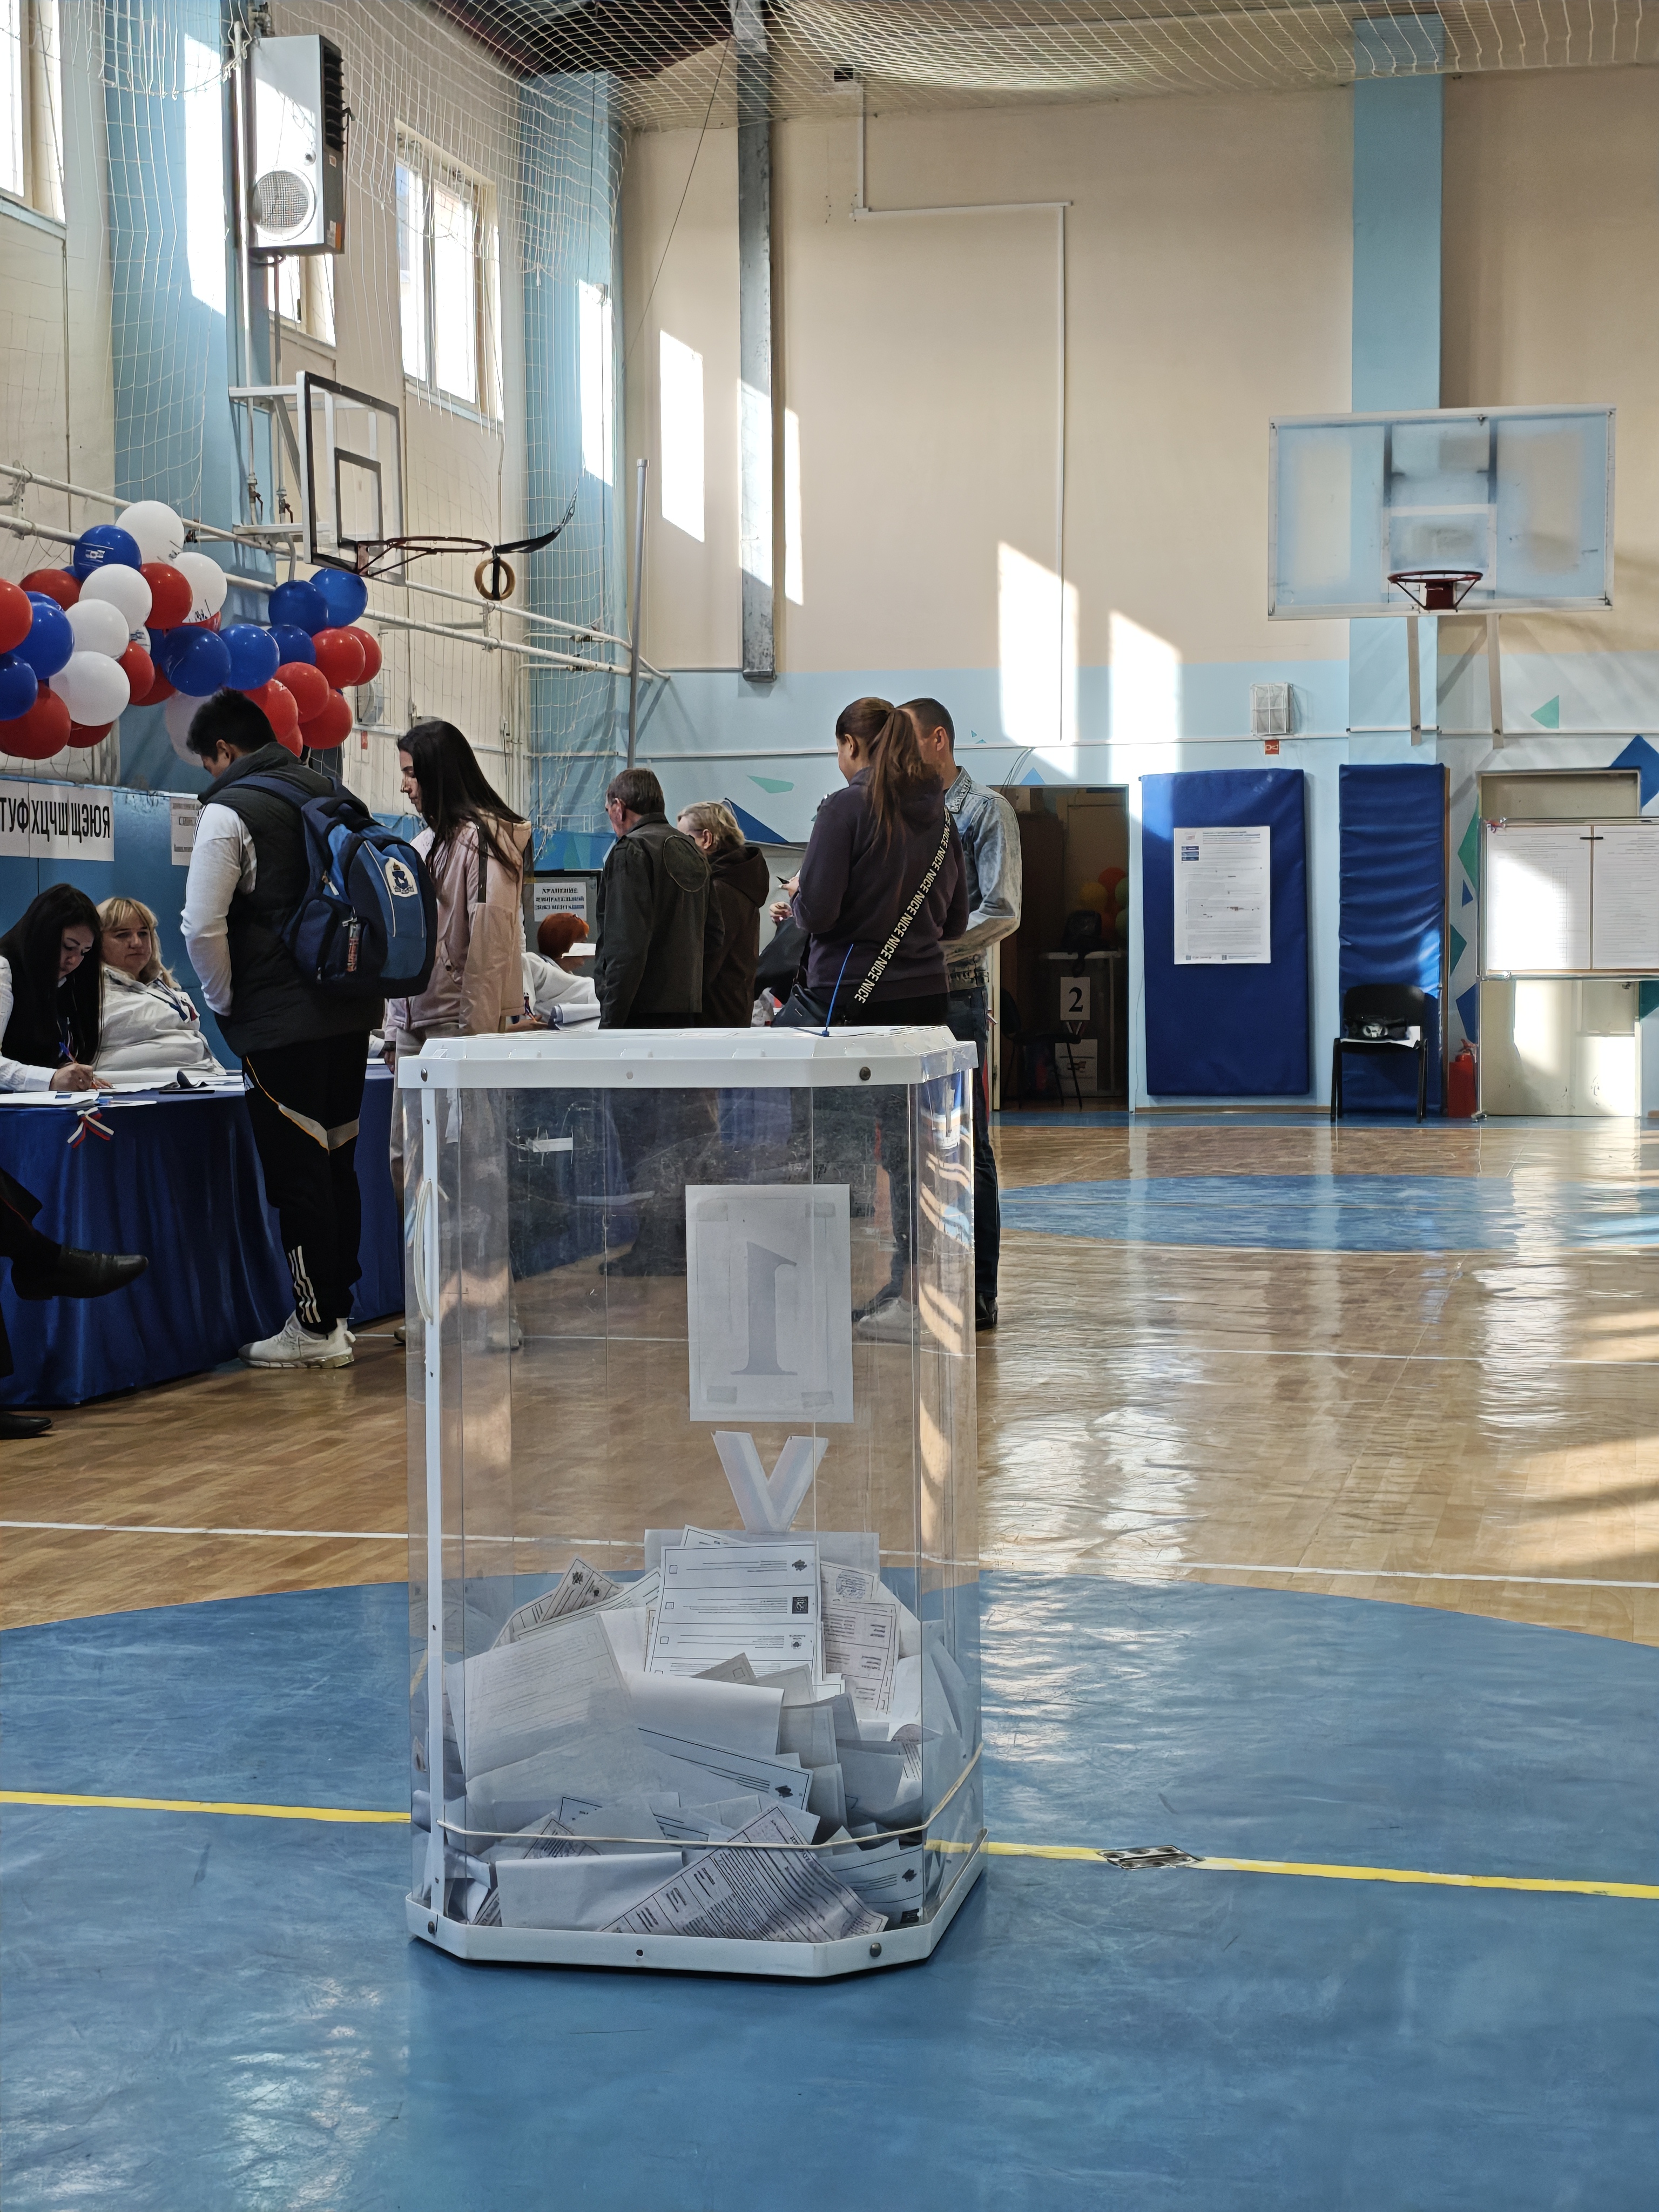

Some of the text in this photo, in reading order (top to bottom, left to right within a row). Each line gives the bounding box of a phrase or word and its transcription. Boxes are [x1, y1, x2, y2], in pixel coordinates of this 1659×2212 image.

[932, 846, 946, 871] NICE
[920, 869, 936, 893] NICE
[907, 891, 925, 915] NICE
[894, 912, 913, 937] NICE
[881, 934, 900, 959] NICE
[867, 956, 887, 981] NICE
[854, 979, 875, 1003] NICE
[1068, 987, 1083, 1012] 2
